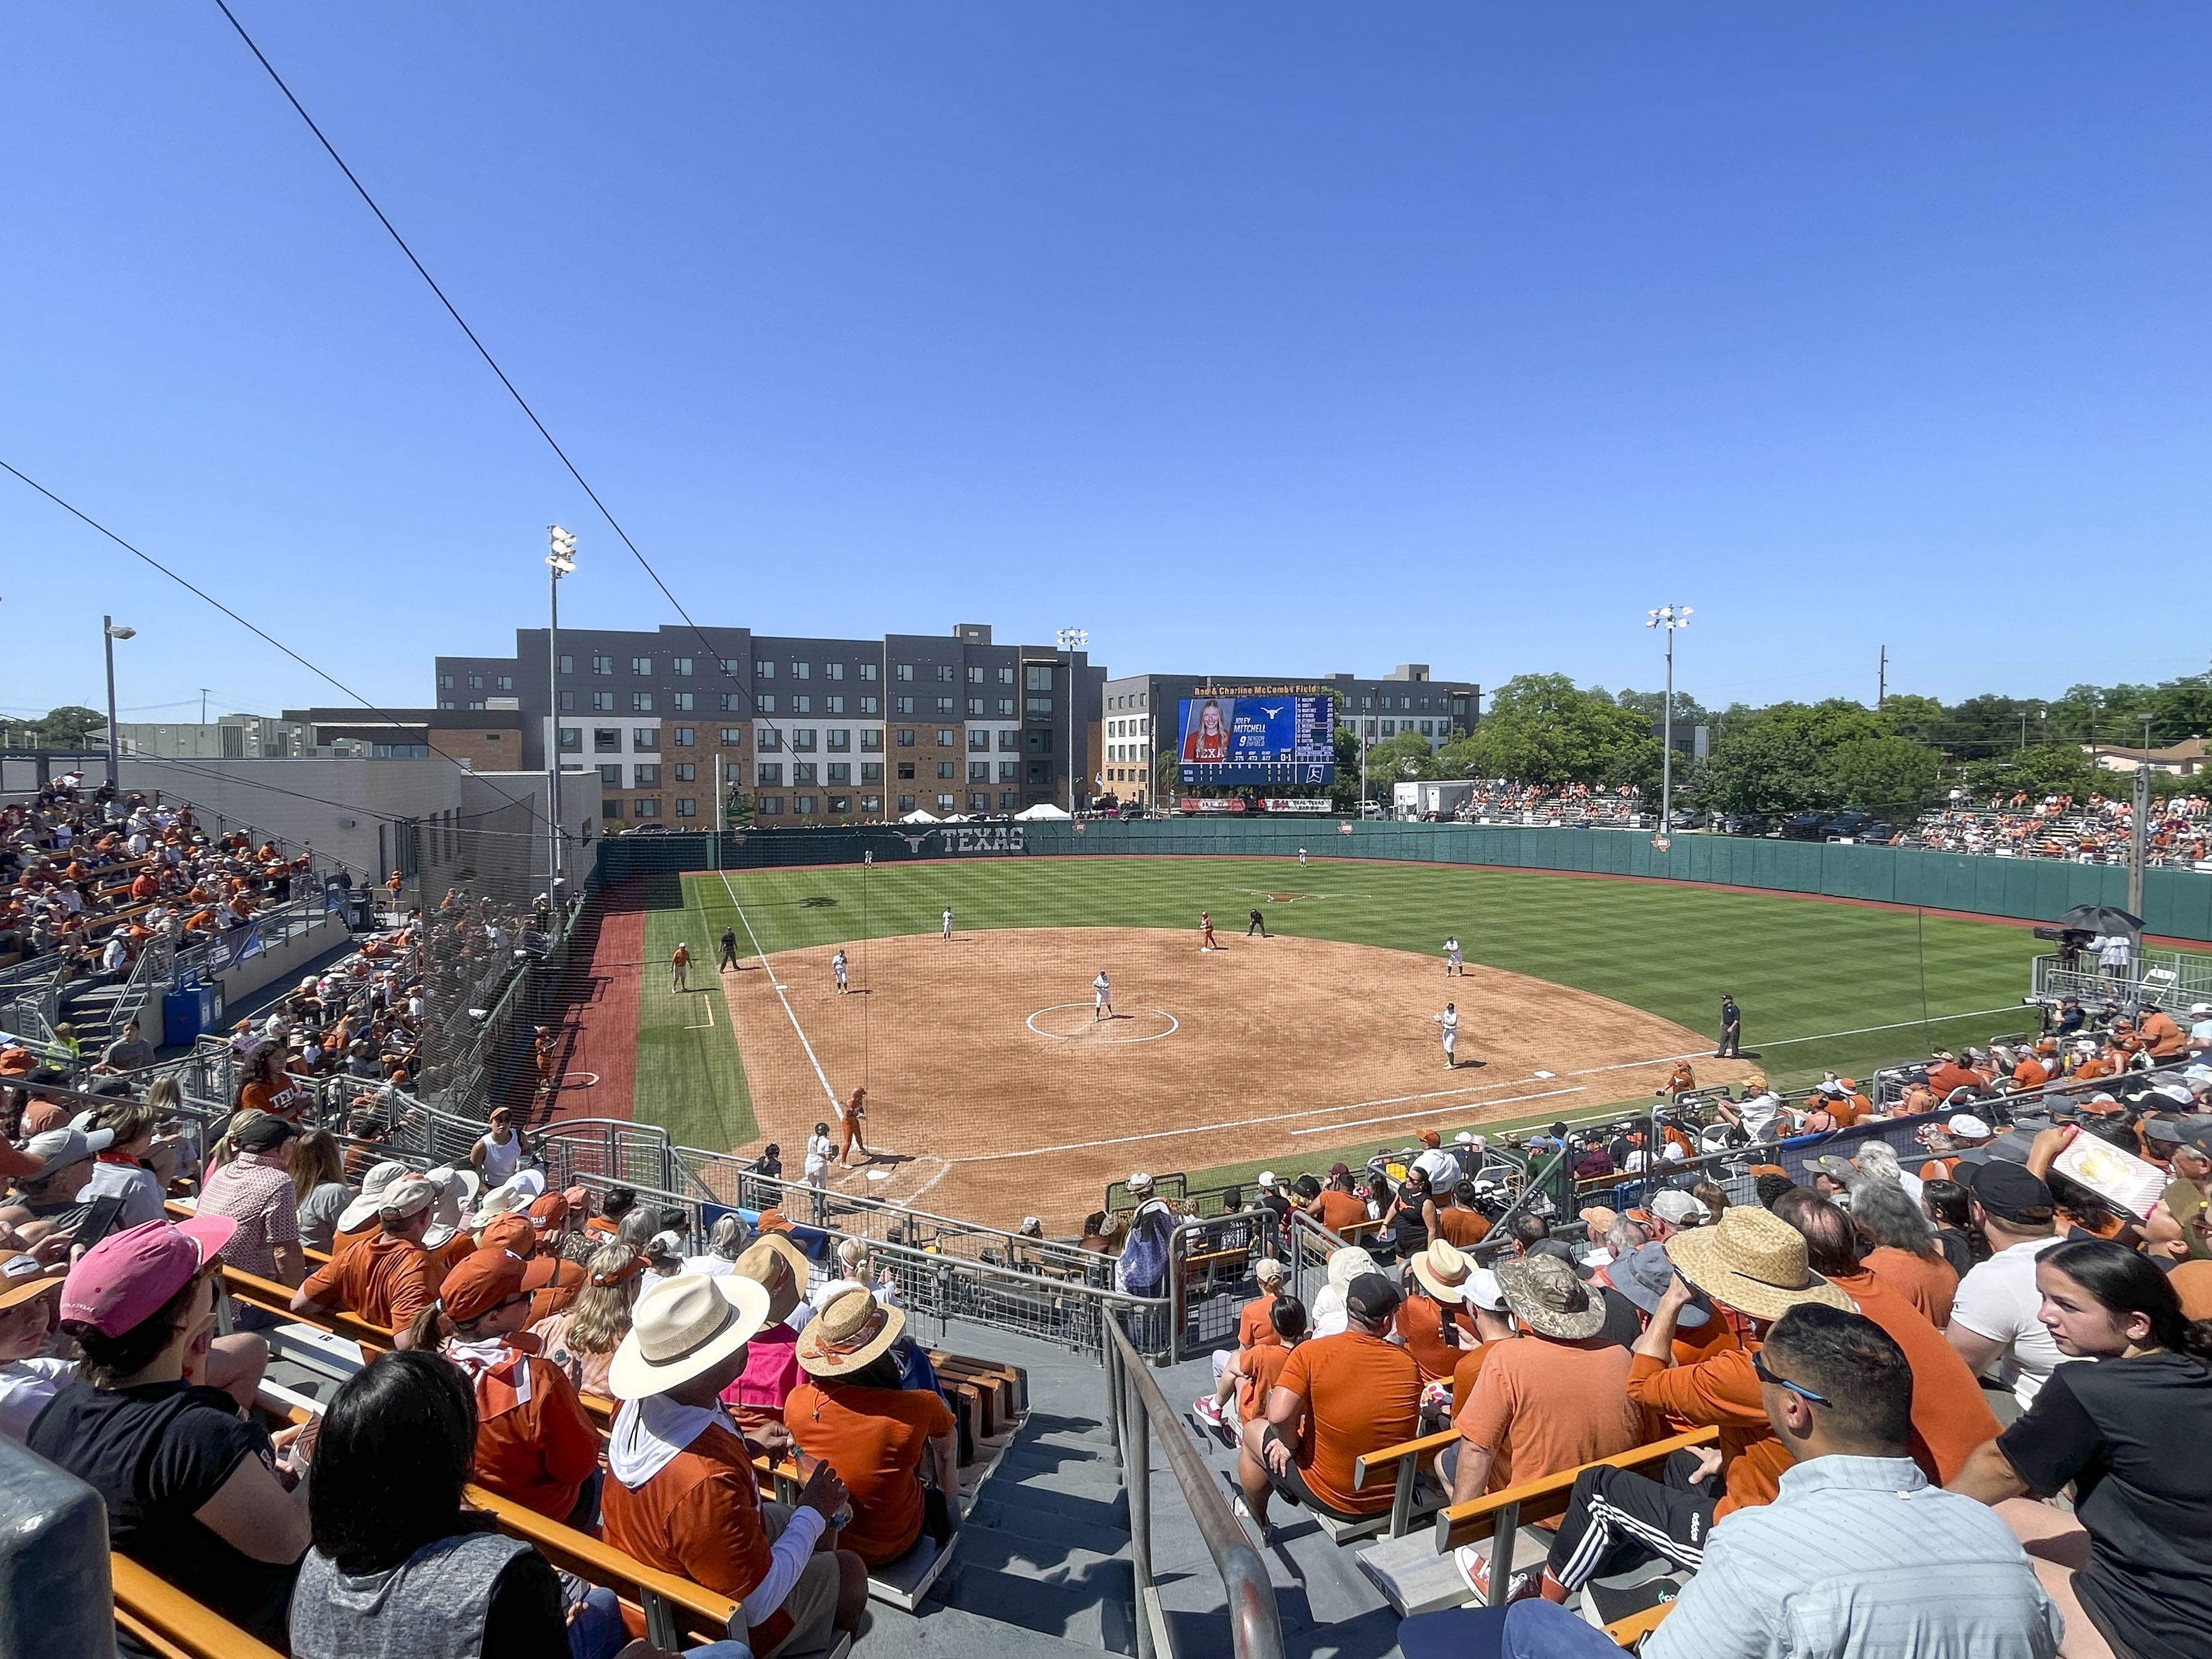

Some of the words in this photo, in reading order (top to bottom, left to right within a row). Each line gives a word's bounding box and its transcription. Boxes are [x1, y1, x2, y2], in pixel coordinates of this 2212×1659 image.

[1195, 687, 1209, 695] Red
[1219, 687, 1252, 695] Charline
[1254, 686, 1294, 694] McCombs
[1296, 685, 1316, 693] Field
[1234, 724, 1266, 733] MITCHELL
[1239, 736, 1247, 747] 9
[940, 827, 1023, 852] TEXAS
[1580, 1195, 1613, 1207] LANDFILL
[1690, 1512, 1700, 1542] adidas
